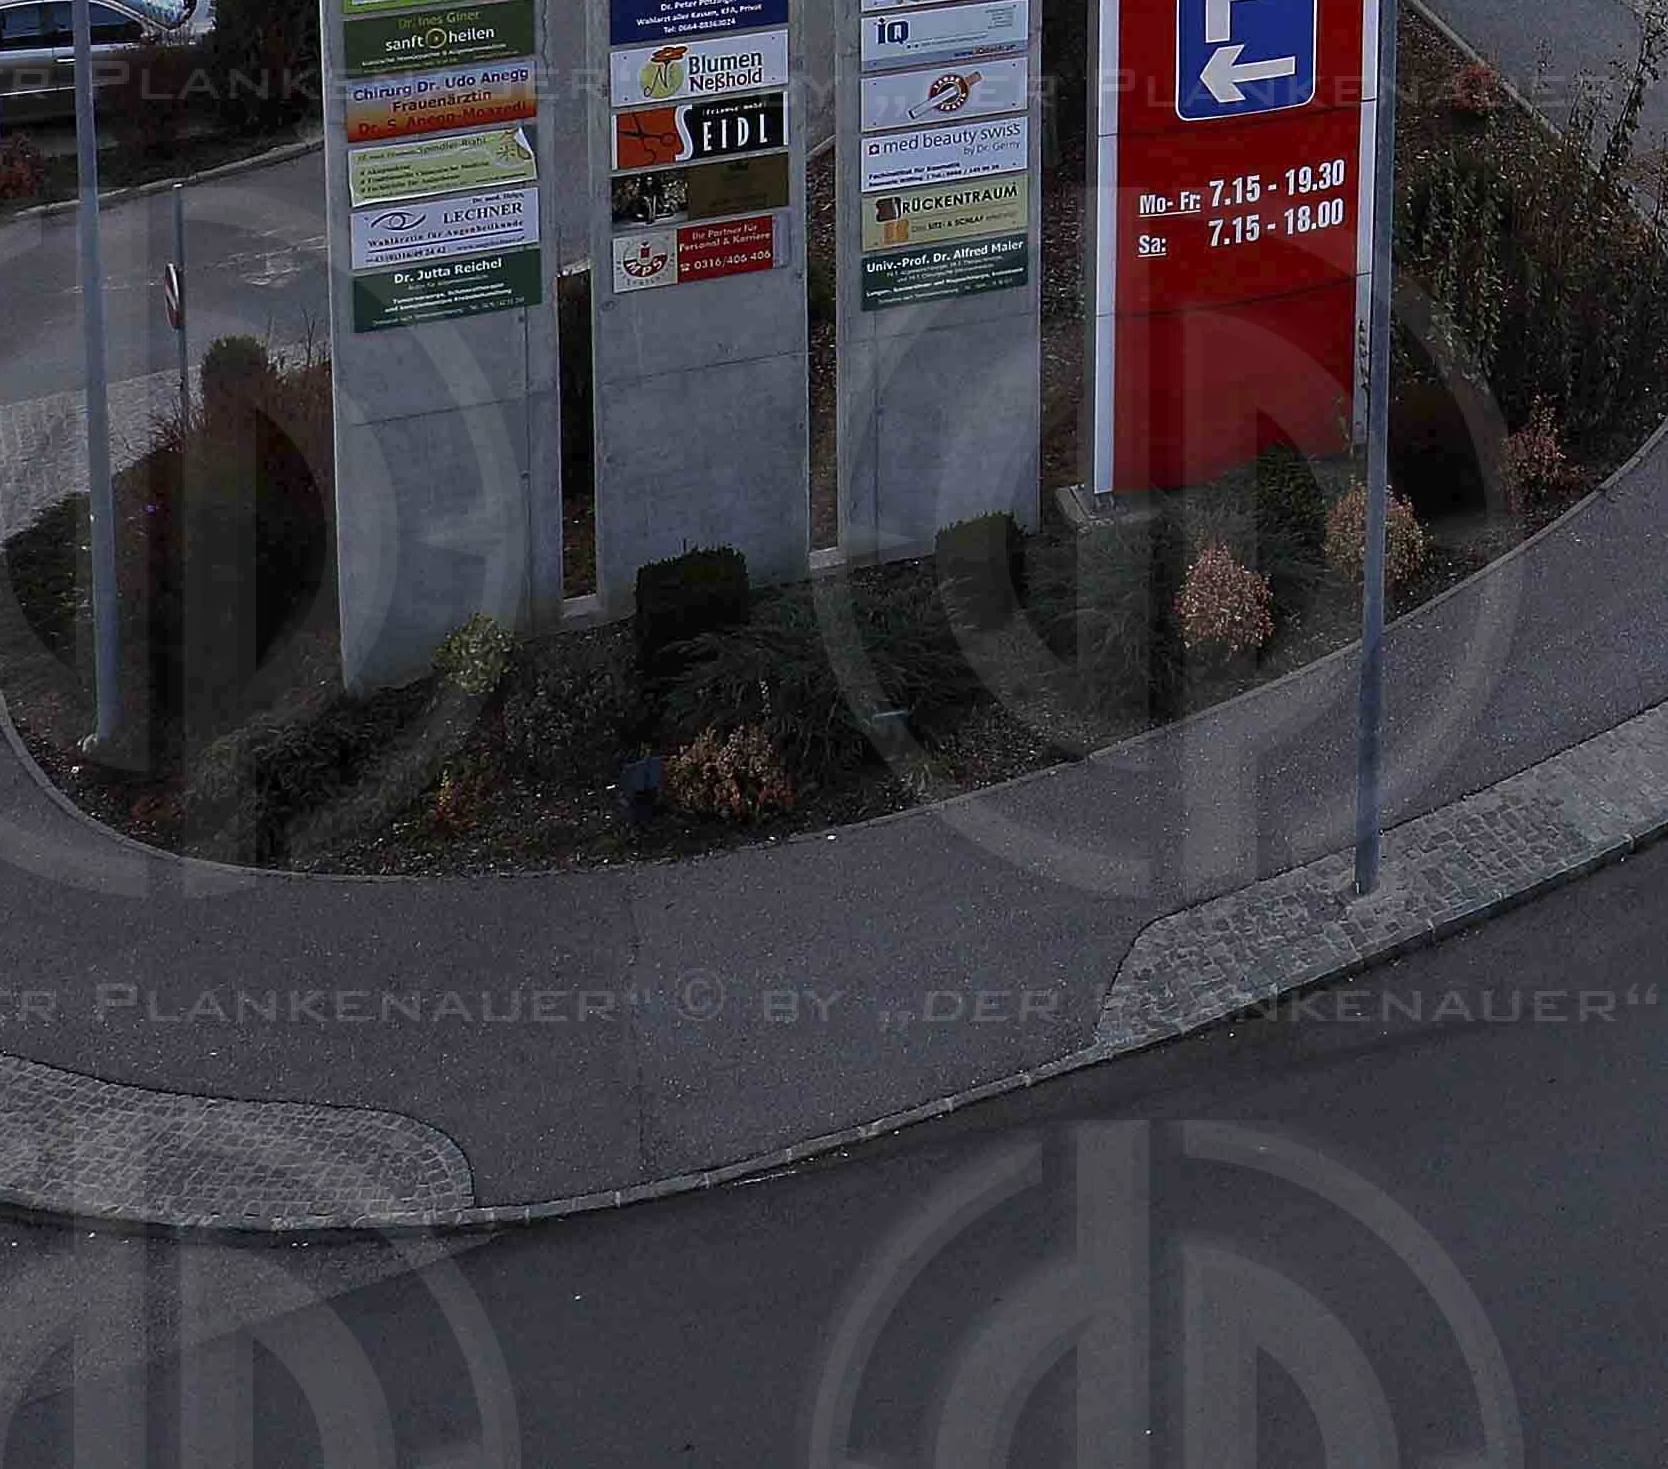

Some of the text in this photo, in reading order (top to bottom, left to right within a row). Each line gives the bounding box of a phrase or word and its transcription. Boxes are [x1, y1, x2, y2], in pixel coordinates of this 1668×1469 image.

[660, 3, 673, 11] Dr.
[675, 0, 697, 11] Peter
[385, 27, 495, 51] sanft heilen
[688, 51, 763, 75] Blumen
[353, 69, 528, 101] Chirurg Dr. Udo Anegg
[689, 68, 763, 92] Neßhold
[393, 90, 492, 113] Frauenärztin
[675, 105, 768, 161] SEIDL
[884, 123, 1020, 154] med beauty swiss
[903, 184, 1018, 214] RÜCKENTRAUM
[1138, 193, 1176, 215] Mo-
[1179, 190, 1202, 212] Fr:
[1208, 175, 1262, 209] 7.15
[1284, 159, 1346, 199] 19.30
[443, 202, 523, 224] LECHNER
[1138, 233, 1167, 256] Sa:
[1208, 214, 1260, 249] 7.15
[1284, 197, 1344, 235] 18.00
[679, 236, 720, 253] Personal
[732, 231, 771, 245] Karriere
[694, 250, 771, 271] 0316/406 406
[867, 255, 930, 273] Univ.-Prof.
[933, 252, 952, 263] Dr.
[953, 245, 988, 261] Alfred
[991, 240, 1024, 253] Maier
[394, 273, 414, 284] Dr.
[418, 266, 451, 280] Jutta
[455, 257, 503, 275] Reichel
